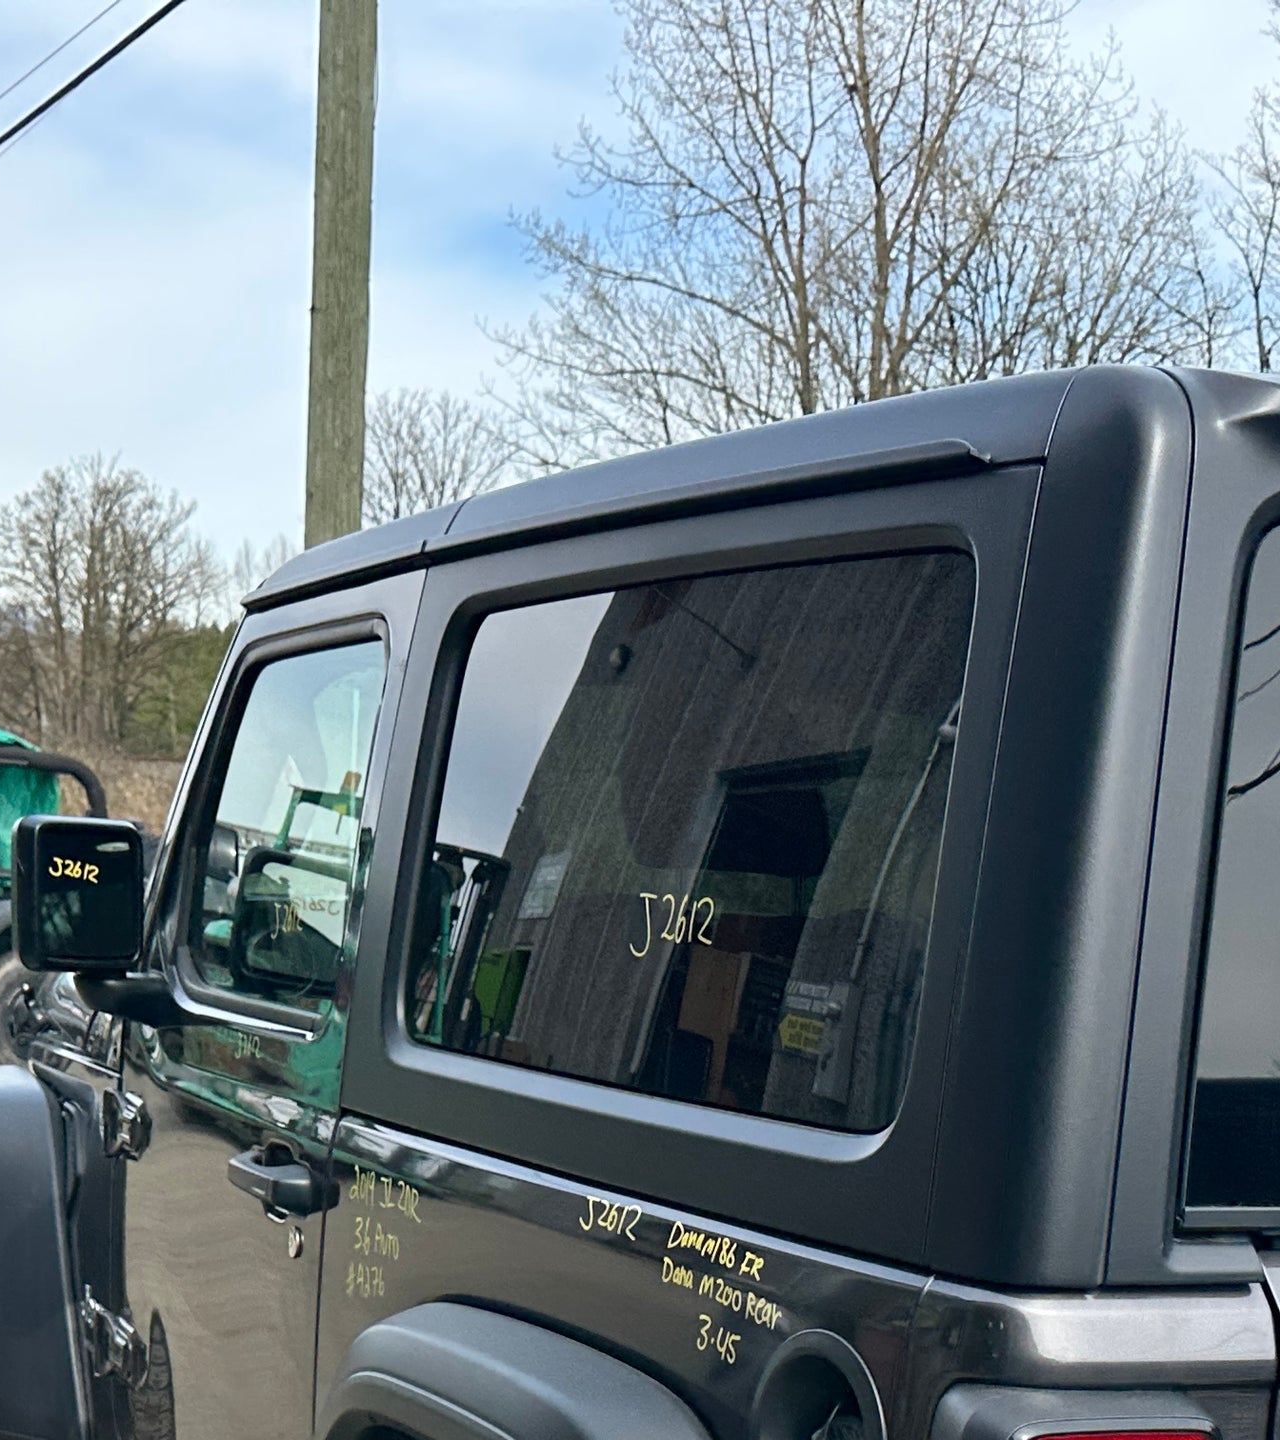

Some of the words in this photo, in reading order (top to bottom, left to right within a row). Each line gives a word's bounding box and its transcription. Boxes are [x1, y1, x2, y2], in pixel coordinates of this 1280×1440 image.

[48, 856, 100, 884] J2612
[628, 892, 715, 957] J2612
[579, 1195, 643, 1241] J2612
[661, 1256, 695, 1289] Dana
[699, 1273, 743, 1312] M200
[696, 1313, 742, 1364] 3.45
